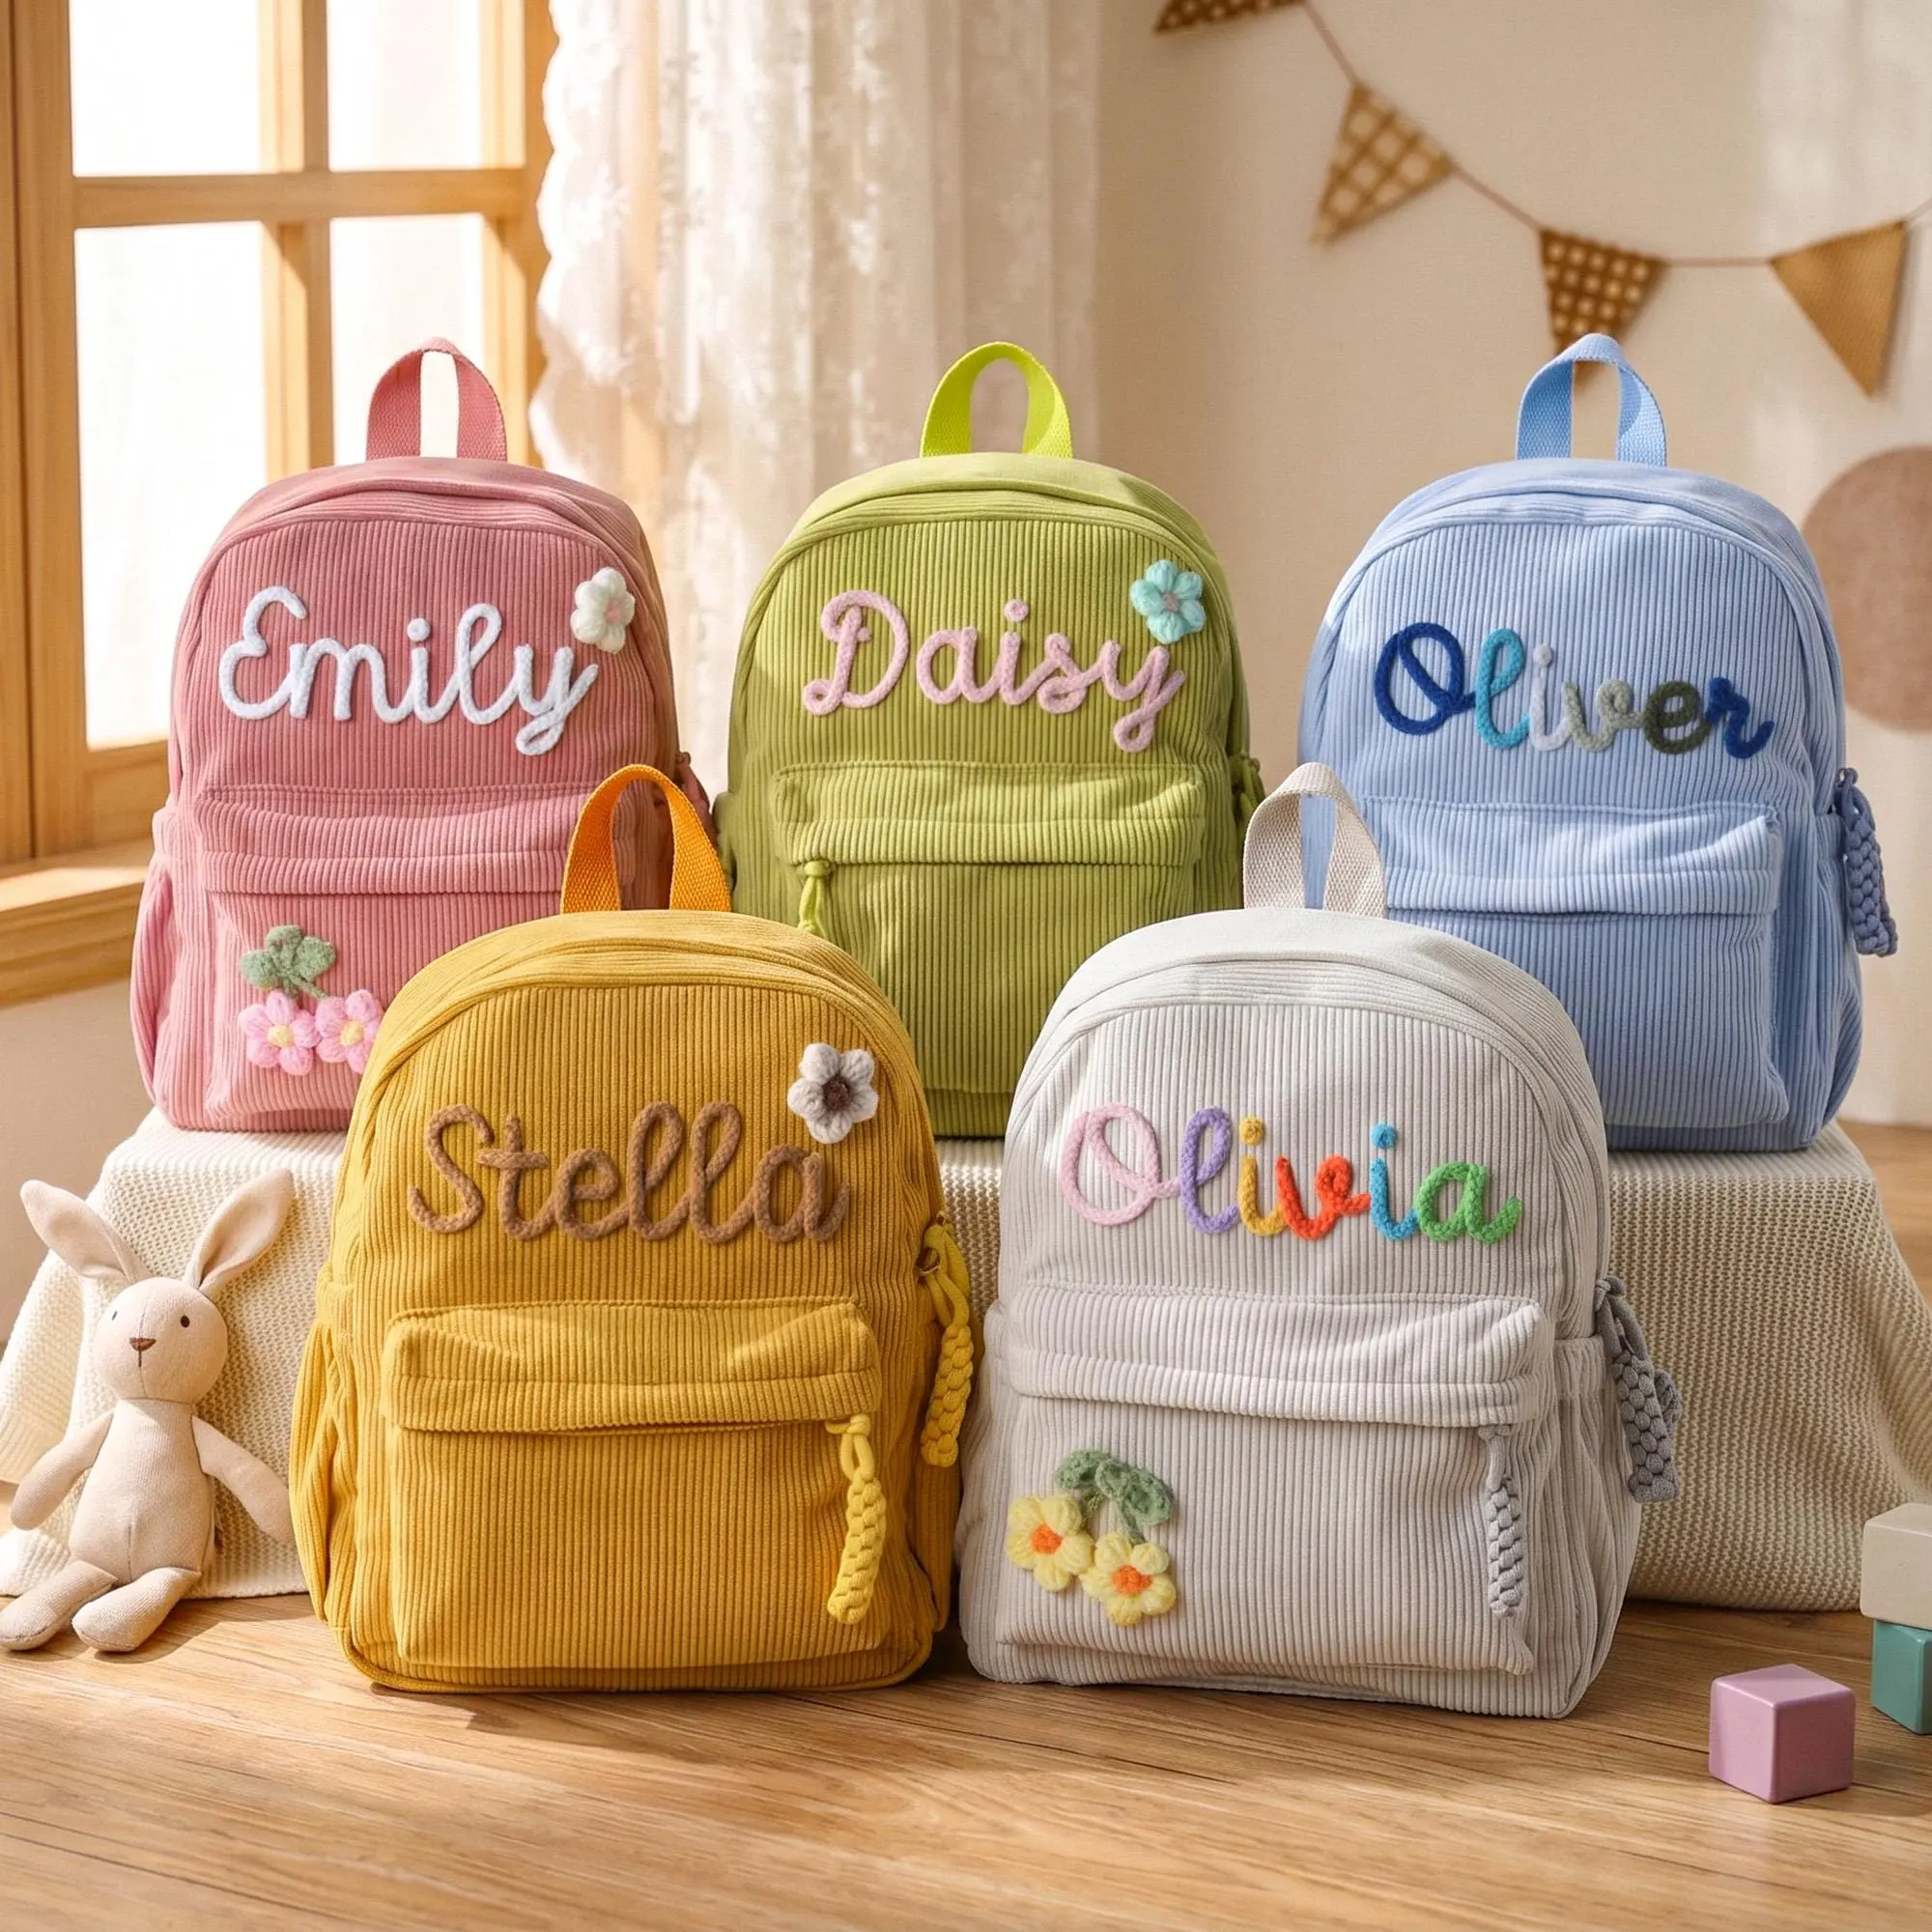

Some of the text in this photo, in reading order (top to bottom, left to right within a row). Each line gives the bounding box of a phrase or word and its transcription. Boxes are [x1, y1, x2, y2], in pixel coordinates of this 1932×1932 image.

[218, 585, 600, 755] Emily
[802, 589, 1186, 753] Daisy
[1374, 621, 1776, 759] Oliver
[407, 1101, 852, 1244] Stella
[1061, 1101, 1523, 1245] Olivia
